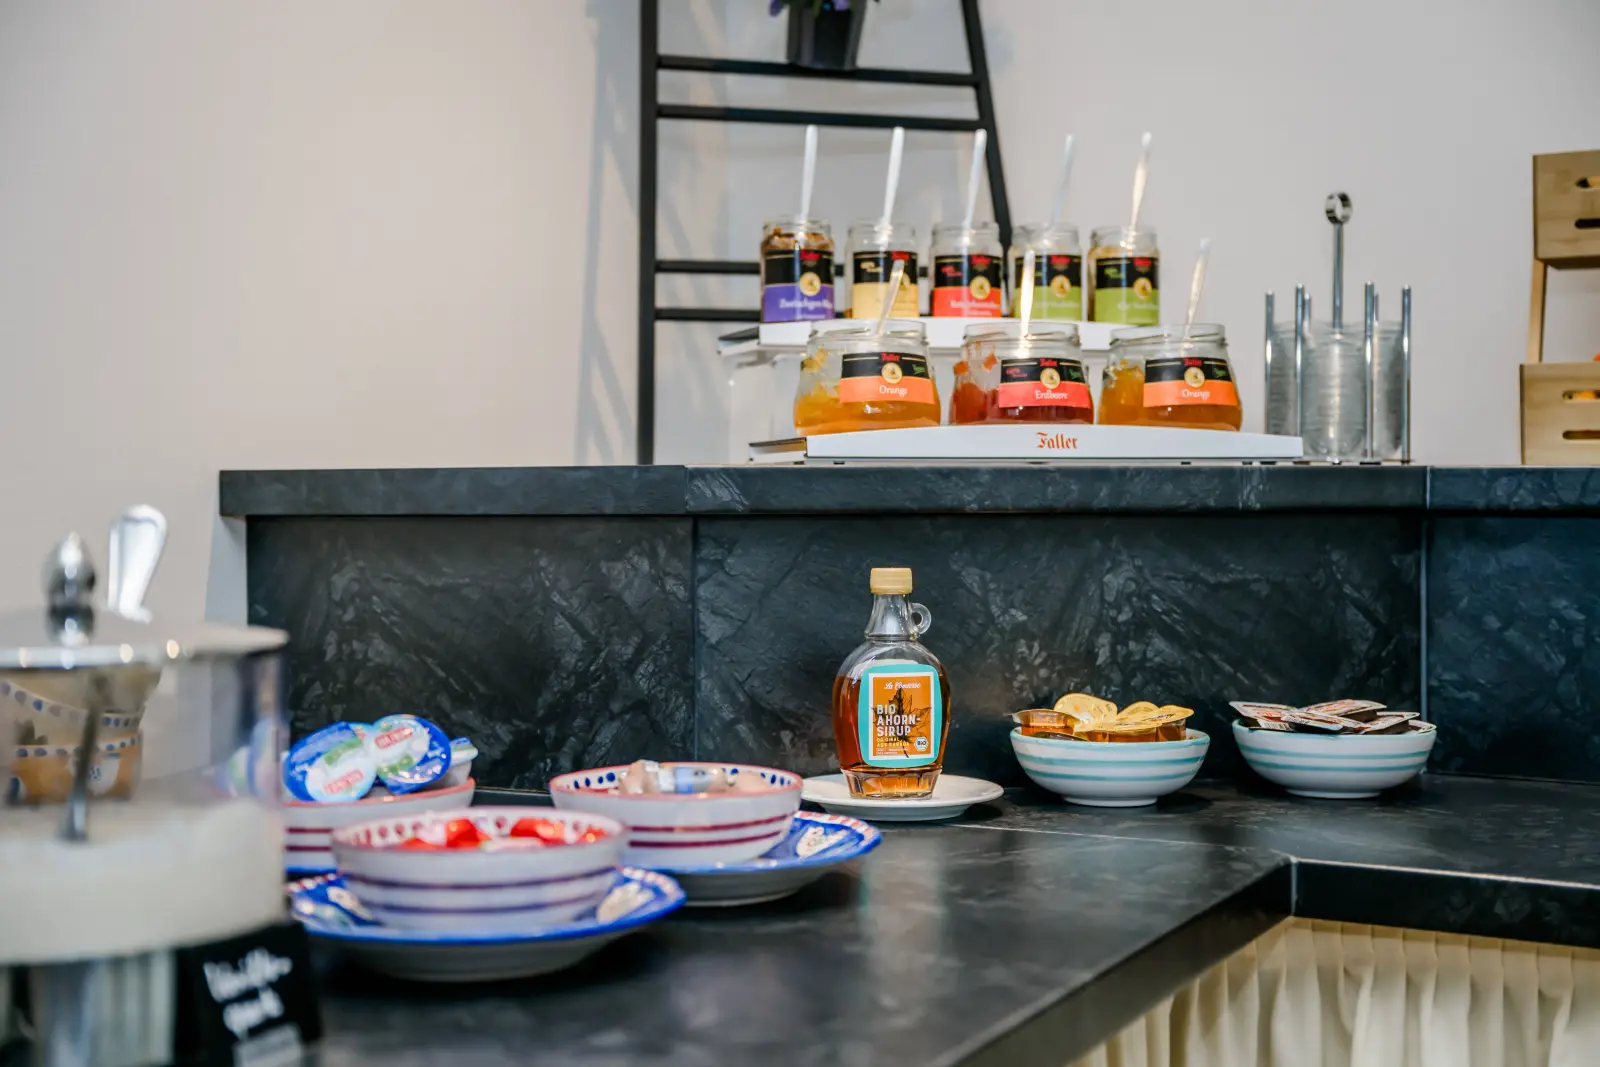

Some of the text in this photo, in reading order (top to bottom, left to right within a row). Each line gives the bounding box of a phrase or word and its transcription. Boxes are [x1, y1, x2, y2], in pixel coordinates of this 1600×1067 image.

[879, 385, 908, 397] Orange
[1035, 389, 1068, 400] Erdbeere
[1037, 432, 1077, 448] Faller
[877, 704, 896, 714] BIO
[877, 715, 921, 725] AHORN-
[877, 726, 911, 736] SIRUP
